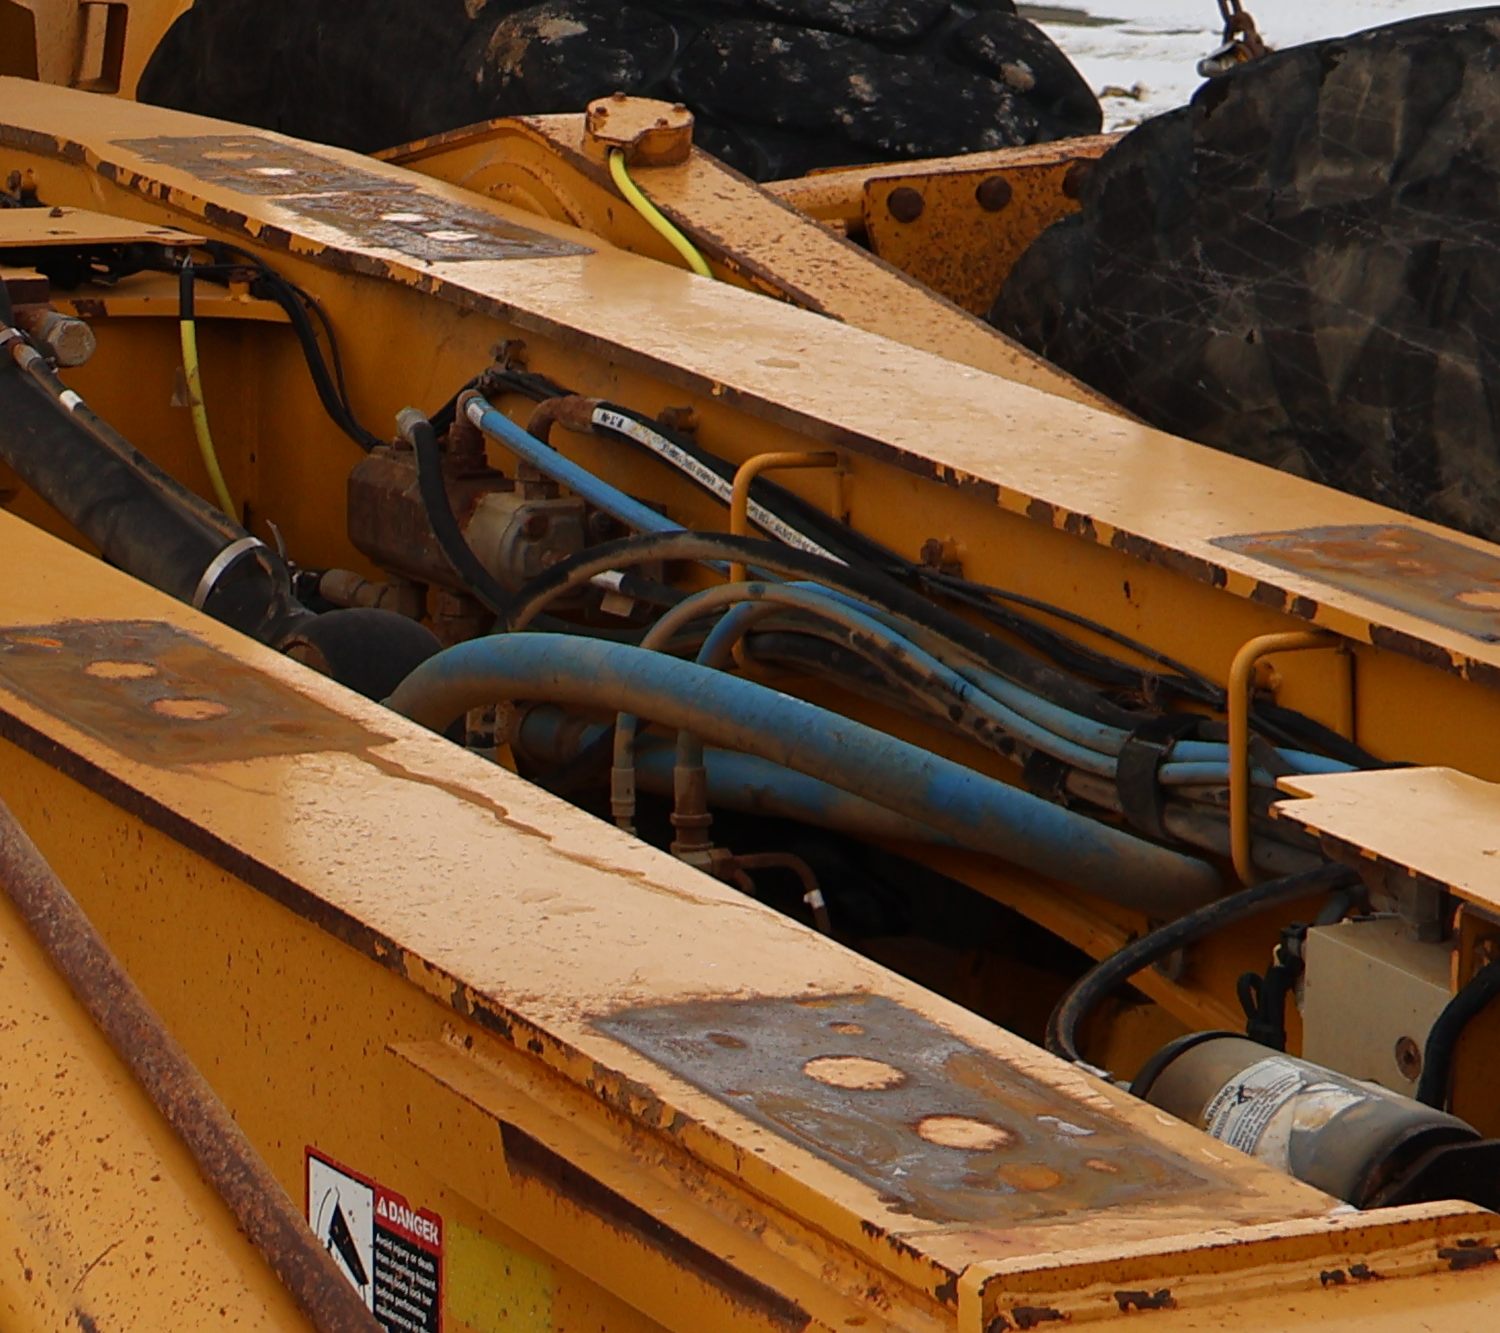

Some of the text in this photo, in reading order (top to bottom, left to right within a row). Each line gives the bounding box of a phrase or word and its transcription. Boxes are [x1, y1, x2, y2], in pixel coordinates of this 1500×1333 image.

[388, 1200, 440, 1246] DANGER
[375, 1232, 393, 1250] Avoid
[410, 1253, 418, 1264] or
